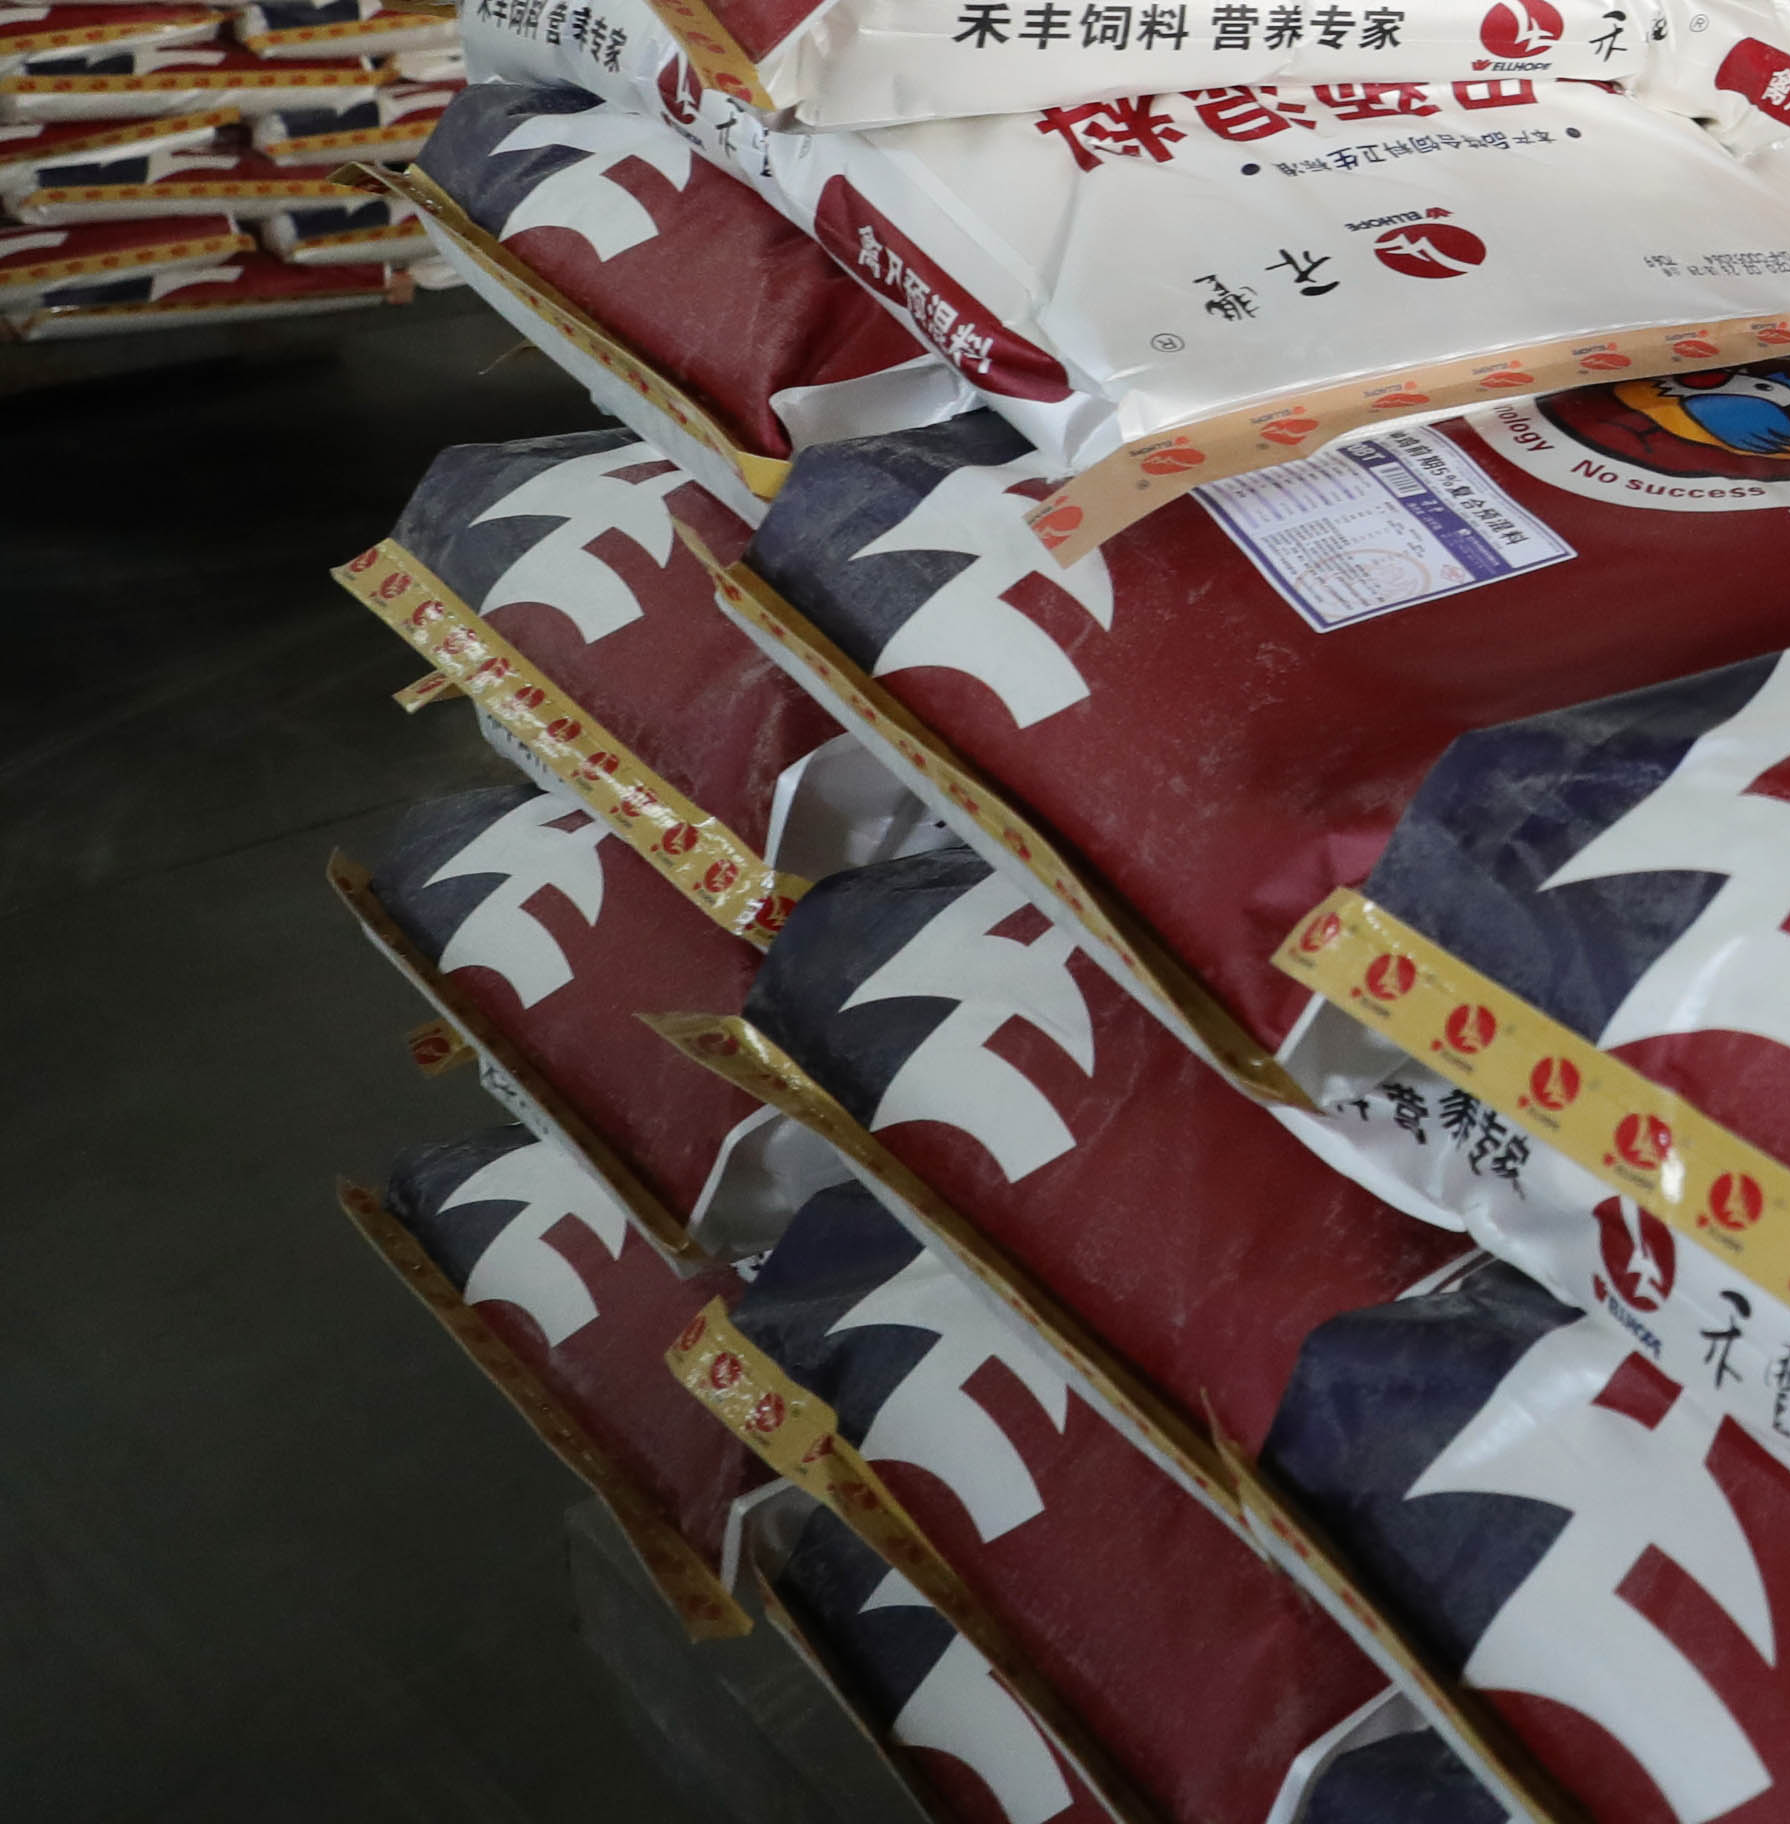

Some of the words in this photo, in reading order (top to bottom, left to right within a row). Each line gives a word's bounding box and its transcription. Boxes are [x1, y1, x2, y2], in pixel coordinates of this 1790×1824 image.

[951, 2, 1190, 53] 禾丰饲料
[1211, 2, 1408, 53] 营养专家
[1344, 205, 1453, 234] WELLHOPE
[1570, 456, 1618, 489] No
[1625, 478, 1767, 503] success
